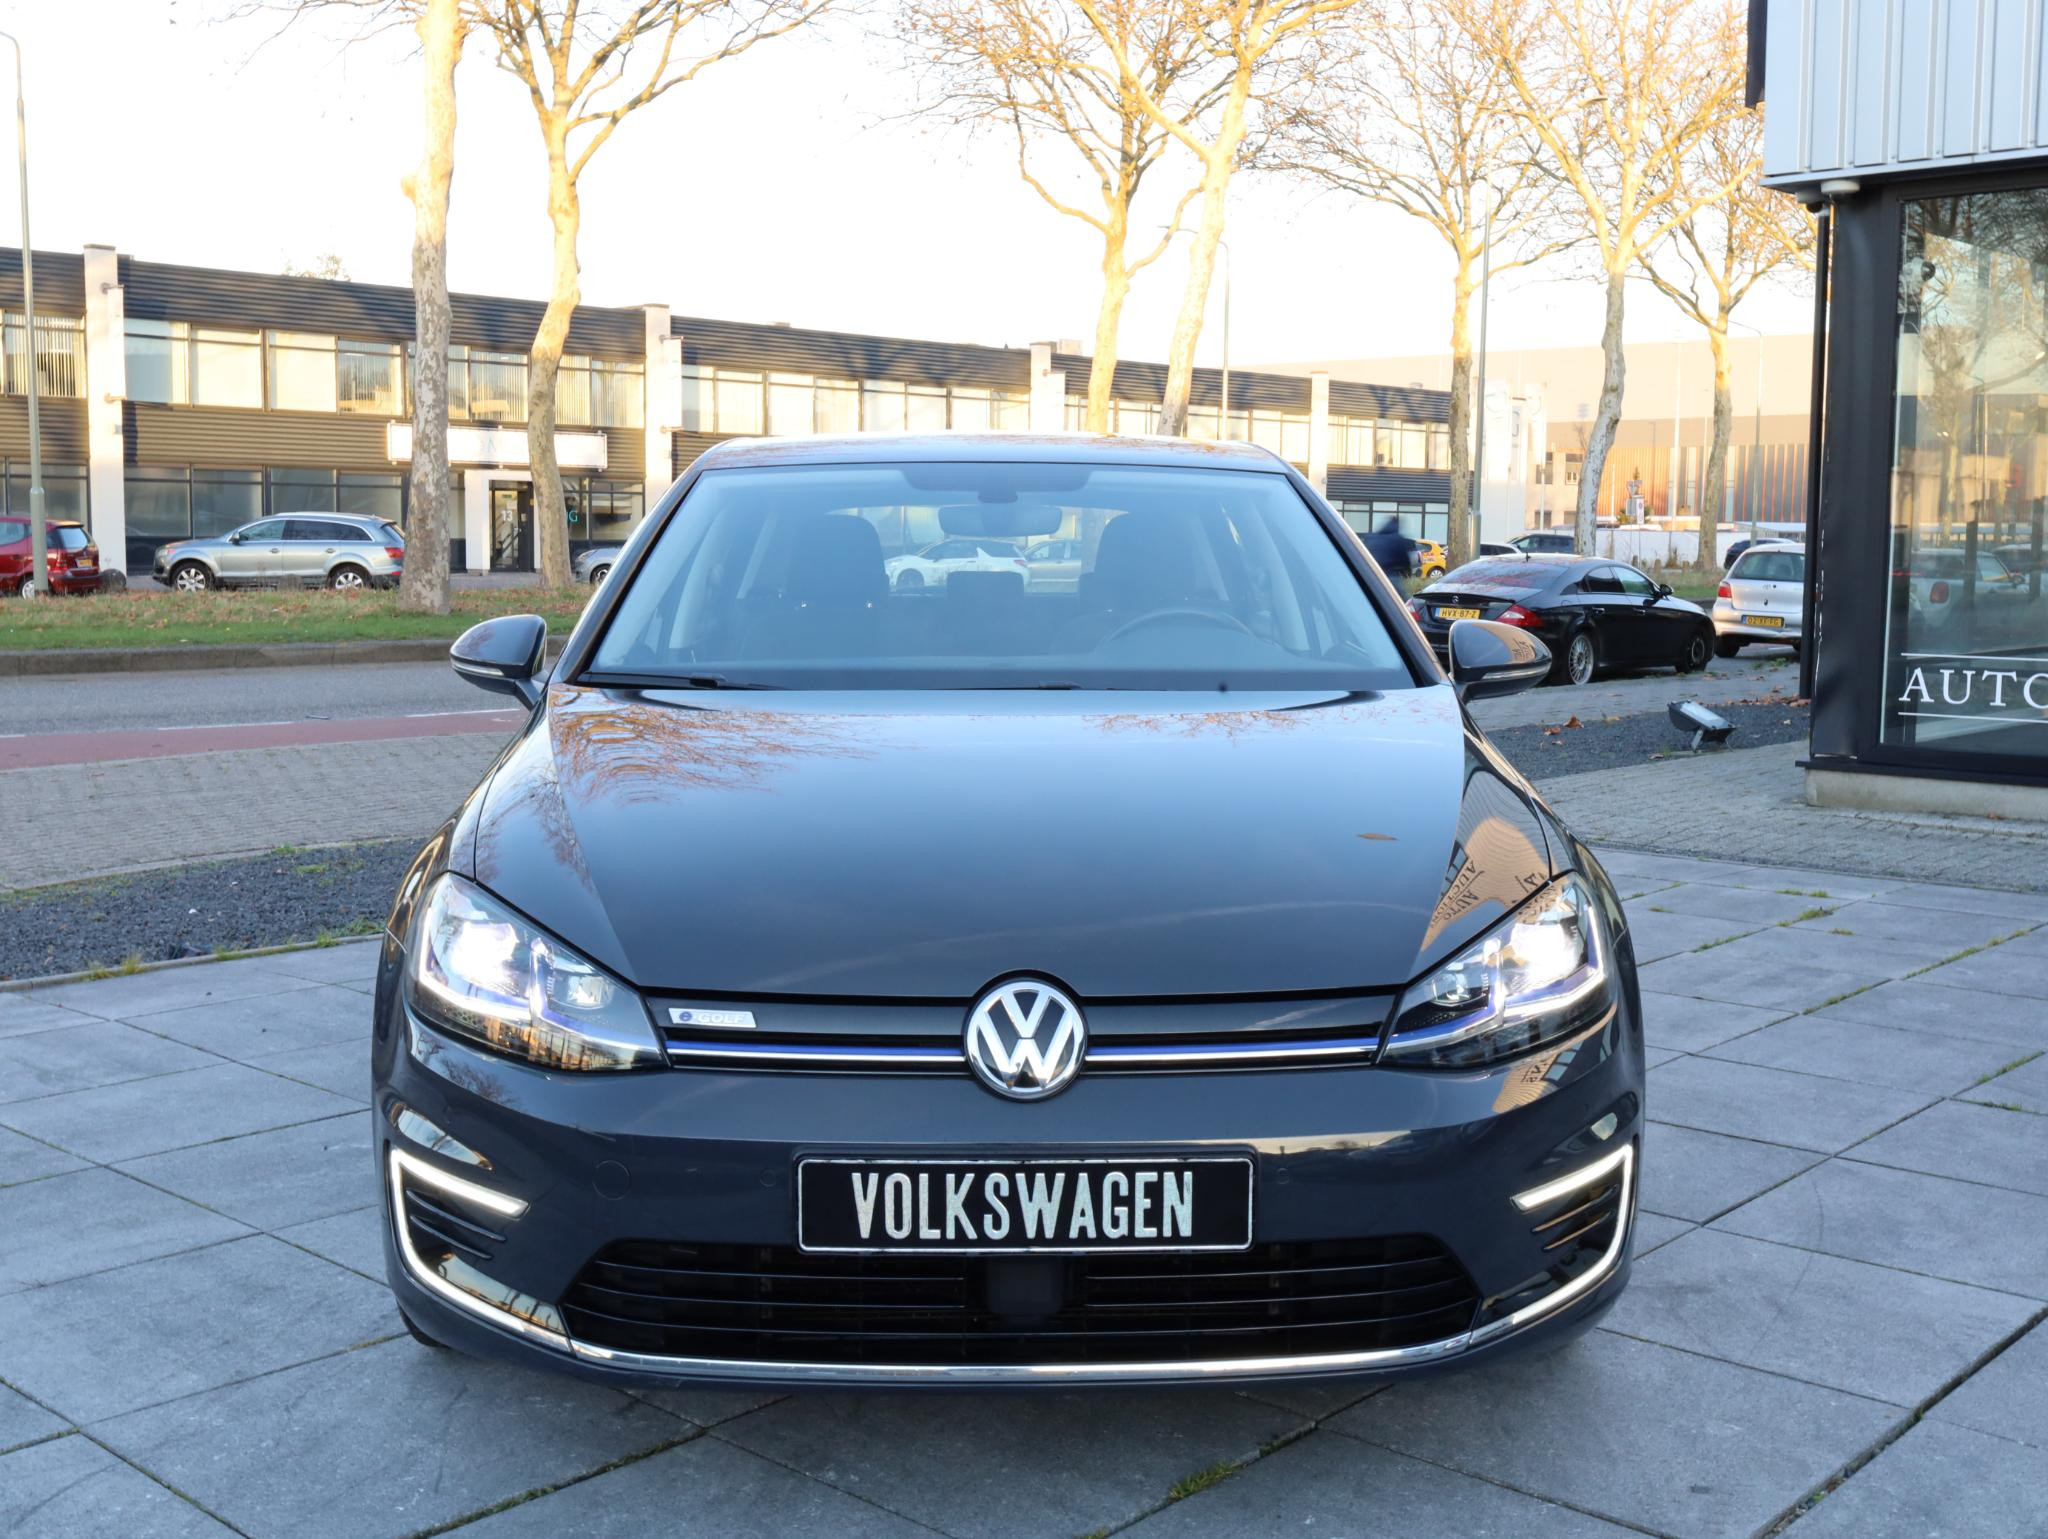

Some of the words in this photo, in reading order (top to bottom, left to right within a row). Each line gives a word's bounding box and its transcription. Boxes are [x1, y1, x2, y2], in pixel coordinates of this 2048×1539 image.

[502, 510, 513, 522] 13
[1898, 667, 2048, 709] AUTO
[970, 986, 1081, 1092] VW
[851, 1172, 1193, 1240] VOLKSWAGEN
